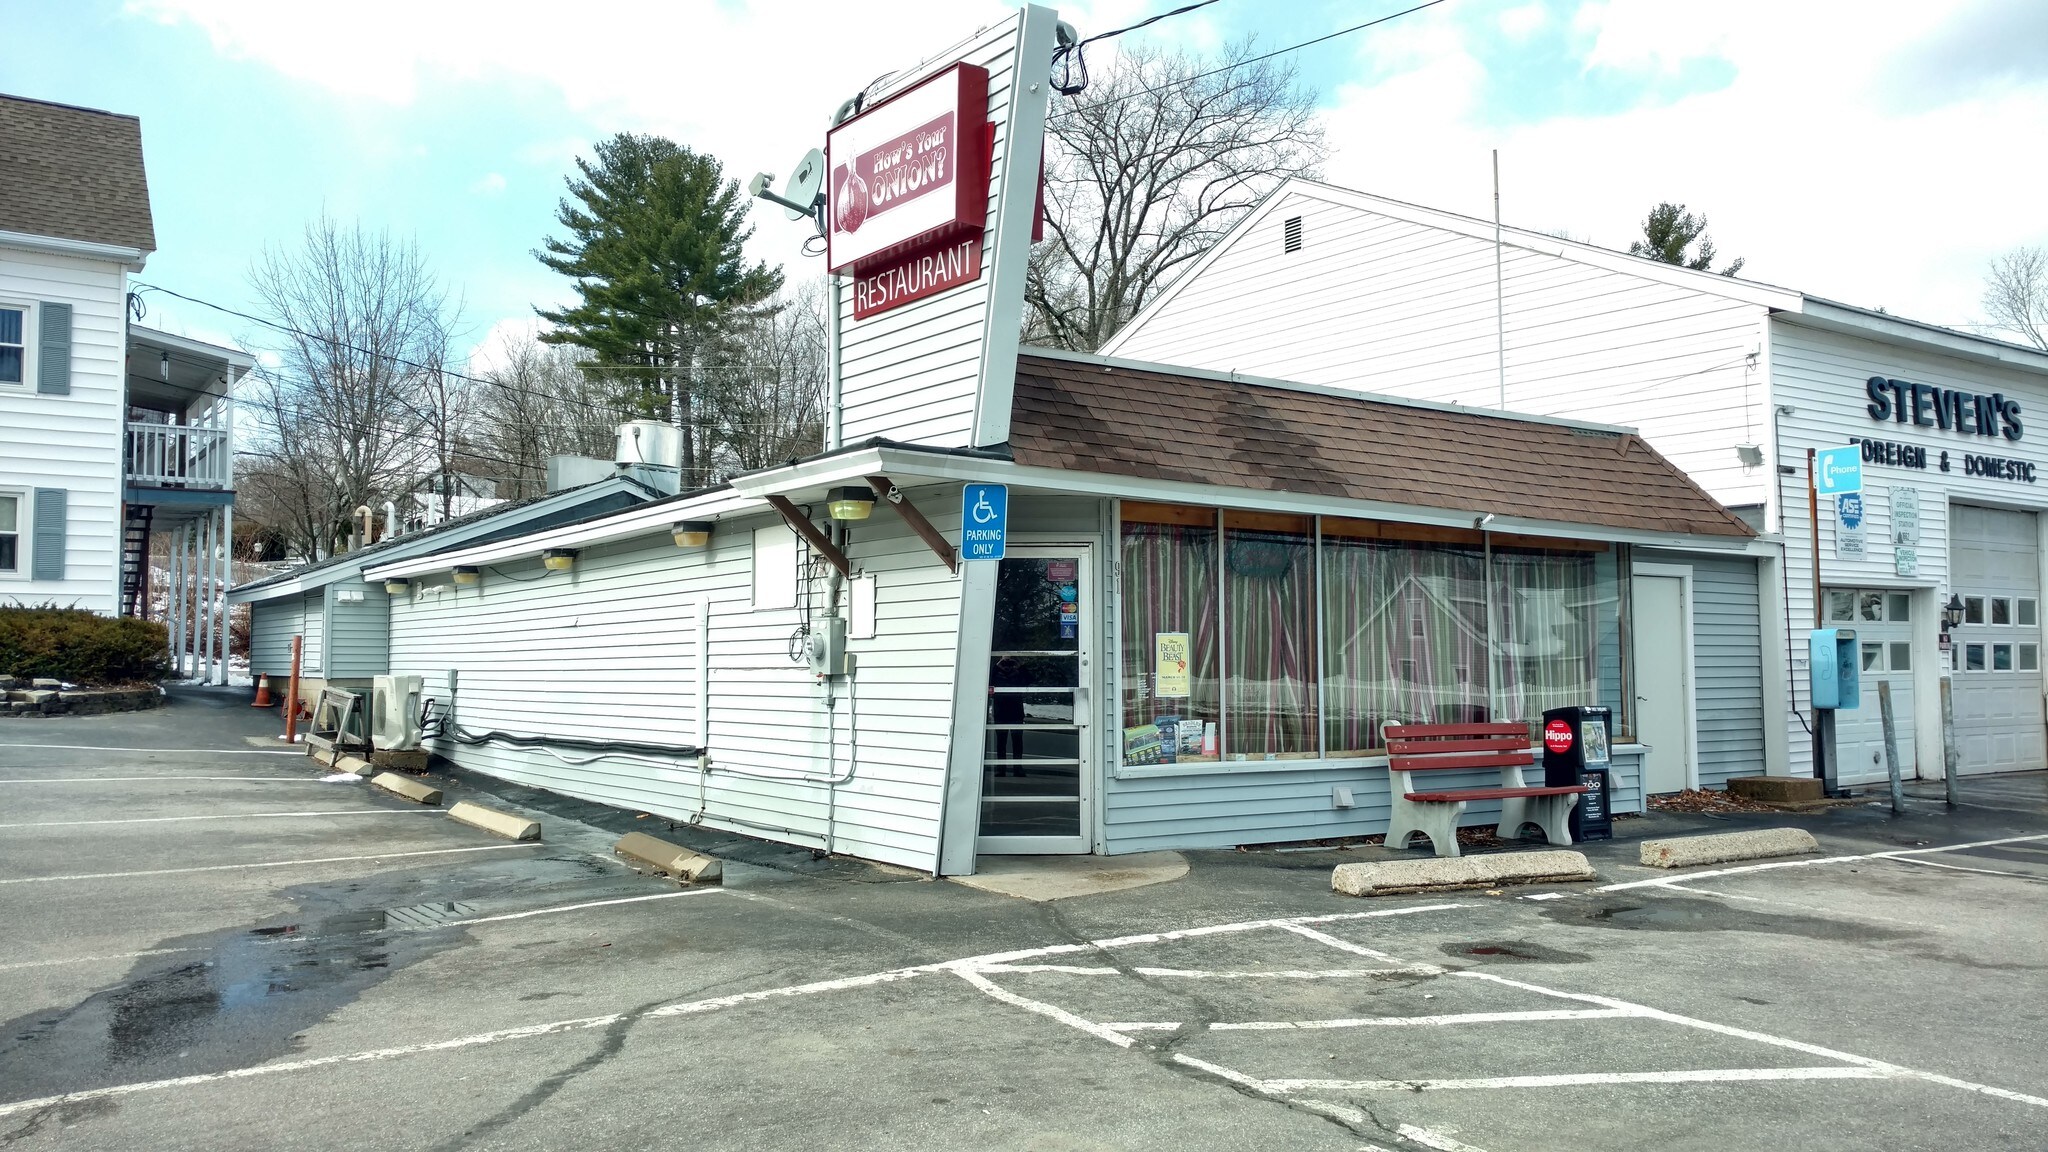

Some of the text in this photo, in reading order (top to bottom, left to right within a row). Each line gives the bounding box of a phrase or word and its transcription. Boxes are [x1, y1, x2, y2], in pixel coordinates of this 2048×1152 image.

[873, 126, 947, 174] How's Your
[872, 146, 947, 206] ONION?
[857, 240, 974, 312] RESTAURANT
[1866, 376, 2024, 441] STEVEN'S
[1831, 465, 1857, 474] Phone
[1940, 450, 1951, 472] &
[1965, 454, 2037, 483] DOMESTIC
[1895, 501, 1915, 509] OFFICIAL
[1894, 511, 1918, 519] INSPECTION
[966, 529, 1002, 541] PARKING
[973, 543, 994, 555] ONLY
[1160, 643, 1185, 651] BEAUTY
[1162, 652, 1184, 661] BEAST
[1545, 730, 1573, 742] Hippo
